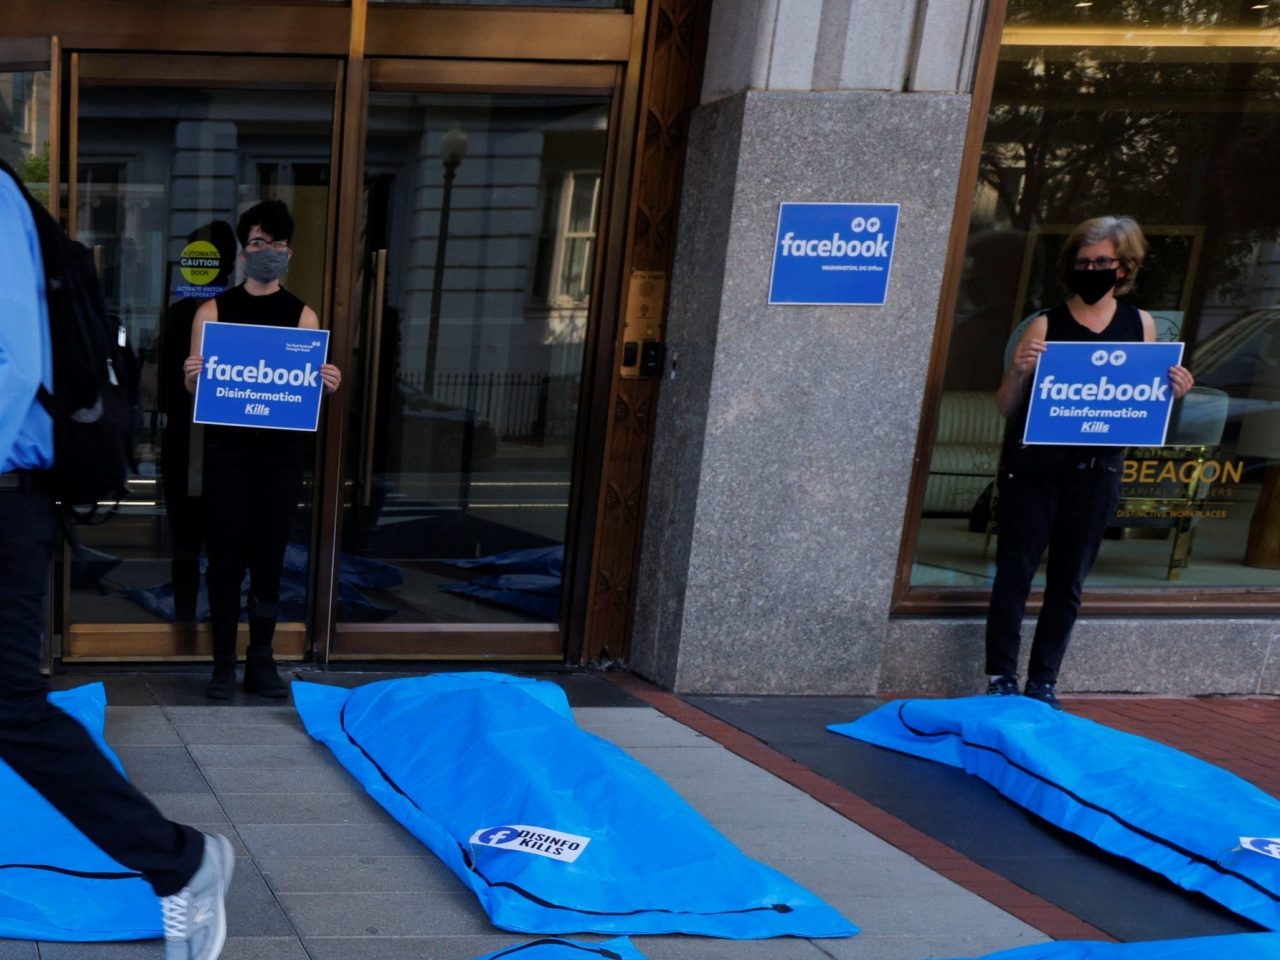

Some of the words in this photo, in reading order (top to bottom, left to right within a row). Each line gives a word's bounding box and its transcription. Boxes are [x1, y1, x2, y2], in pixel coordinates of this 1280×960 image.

[781, 231, 889, 257] facebook
[180, 258, 220, 267] CAUTION
[205, 355, 320, 387] facebook
[216, 387, 302, 403] Disinformation
[1039, 375, 1168, 401] facebook
[244, 403, 270, 416] Kills
[1049, 406, 1148, 419] Disinformation
[1080, 421, 1110, 434] Kills
[1120, 460, 1244, 484] BEACON
[517, 830, 580, 851] DISINFO
[519, 839, 564, 856] KILLS
